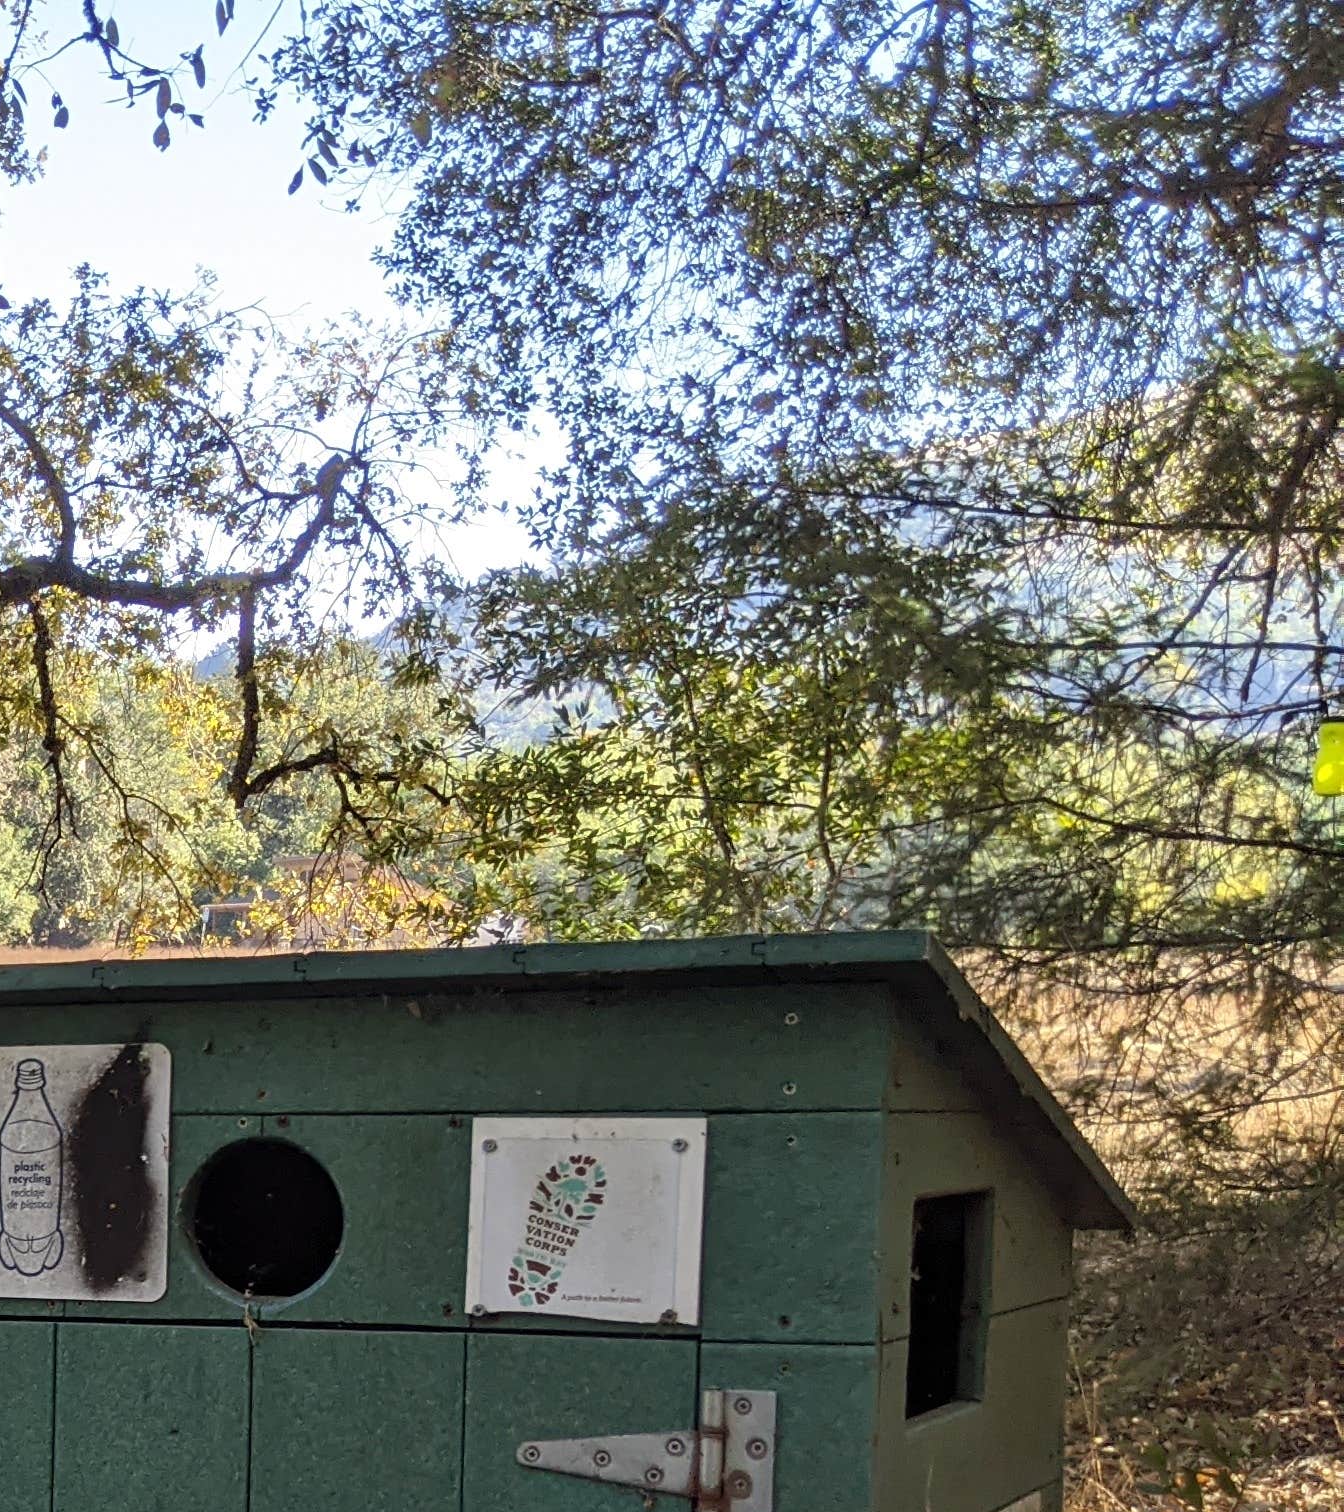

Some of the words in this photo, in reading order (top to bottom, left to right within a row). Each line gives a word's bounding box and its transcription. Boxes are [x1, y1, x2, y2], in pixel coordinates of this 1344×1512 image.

[14, 1160, 46, 1174] plastic
[8, 1173, 52, 1186] recycling
[527, 1214, 580, 1237] CONSER
[526, 1224, 576, 1248] VATION
[525, 1237, 568, 1257] CORPS
